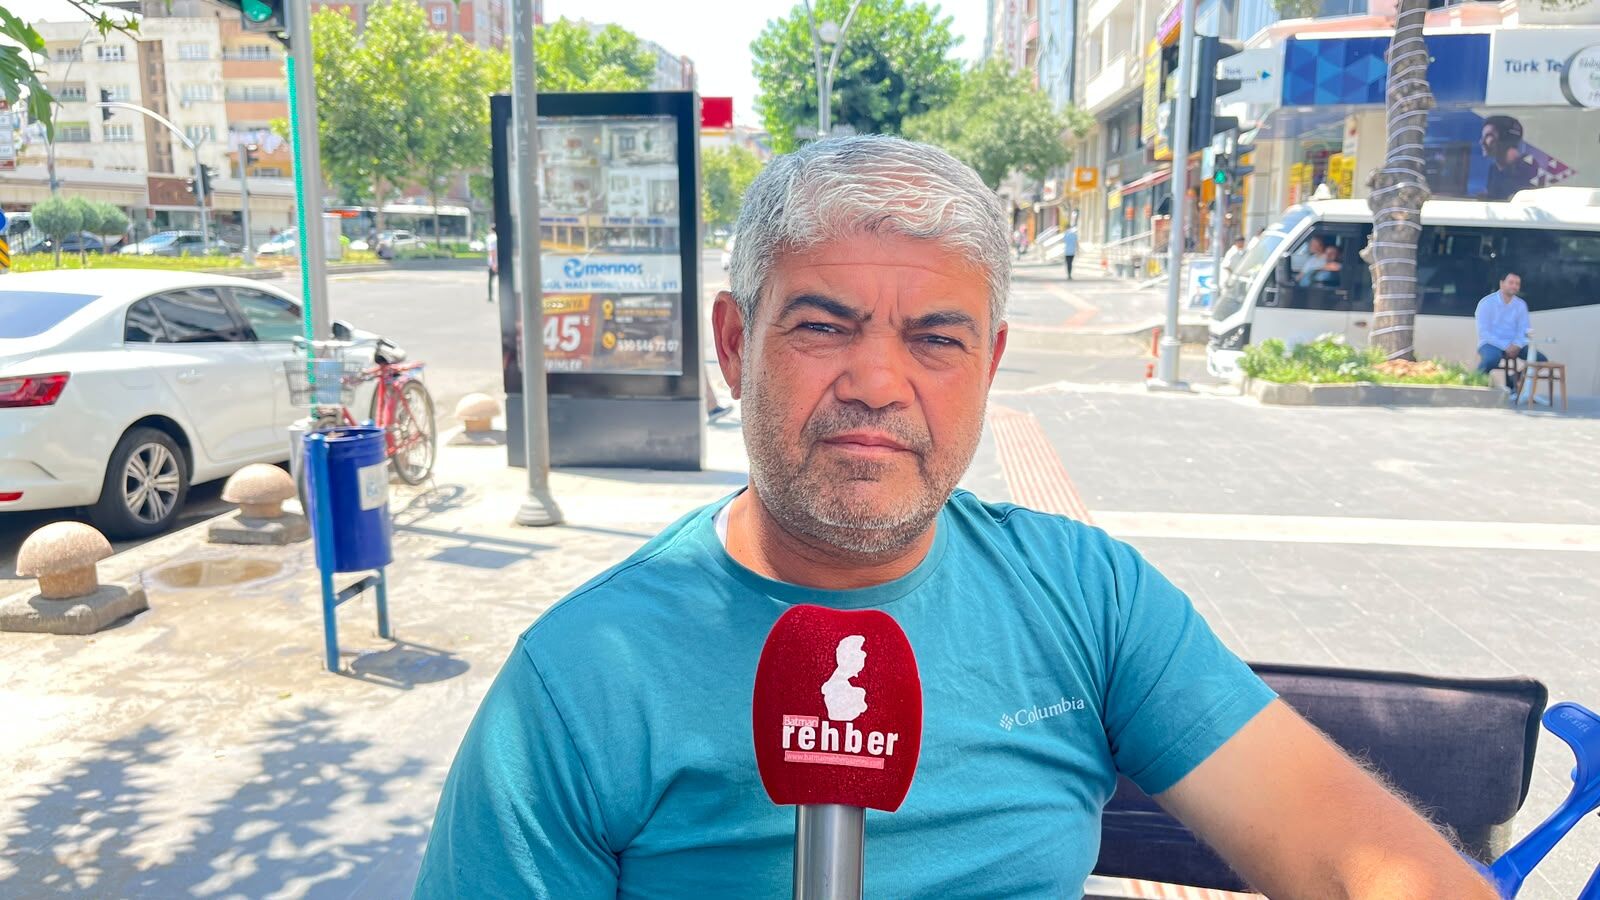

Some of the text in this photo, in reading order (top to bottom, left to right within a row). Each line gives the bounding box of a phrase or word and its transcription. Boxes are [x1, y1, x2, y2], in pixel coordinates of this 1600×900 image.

[1504, 59, 1539, 73] Türk
[1546, 59, 1563, 73] Te
[784, 715, 818, 727] Batman
[1014, 697, 1085, 726] Columbia
[782, 720, 899, 756] rehber
